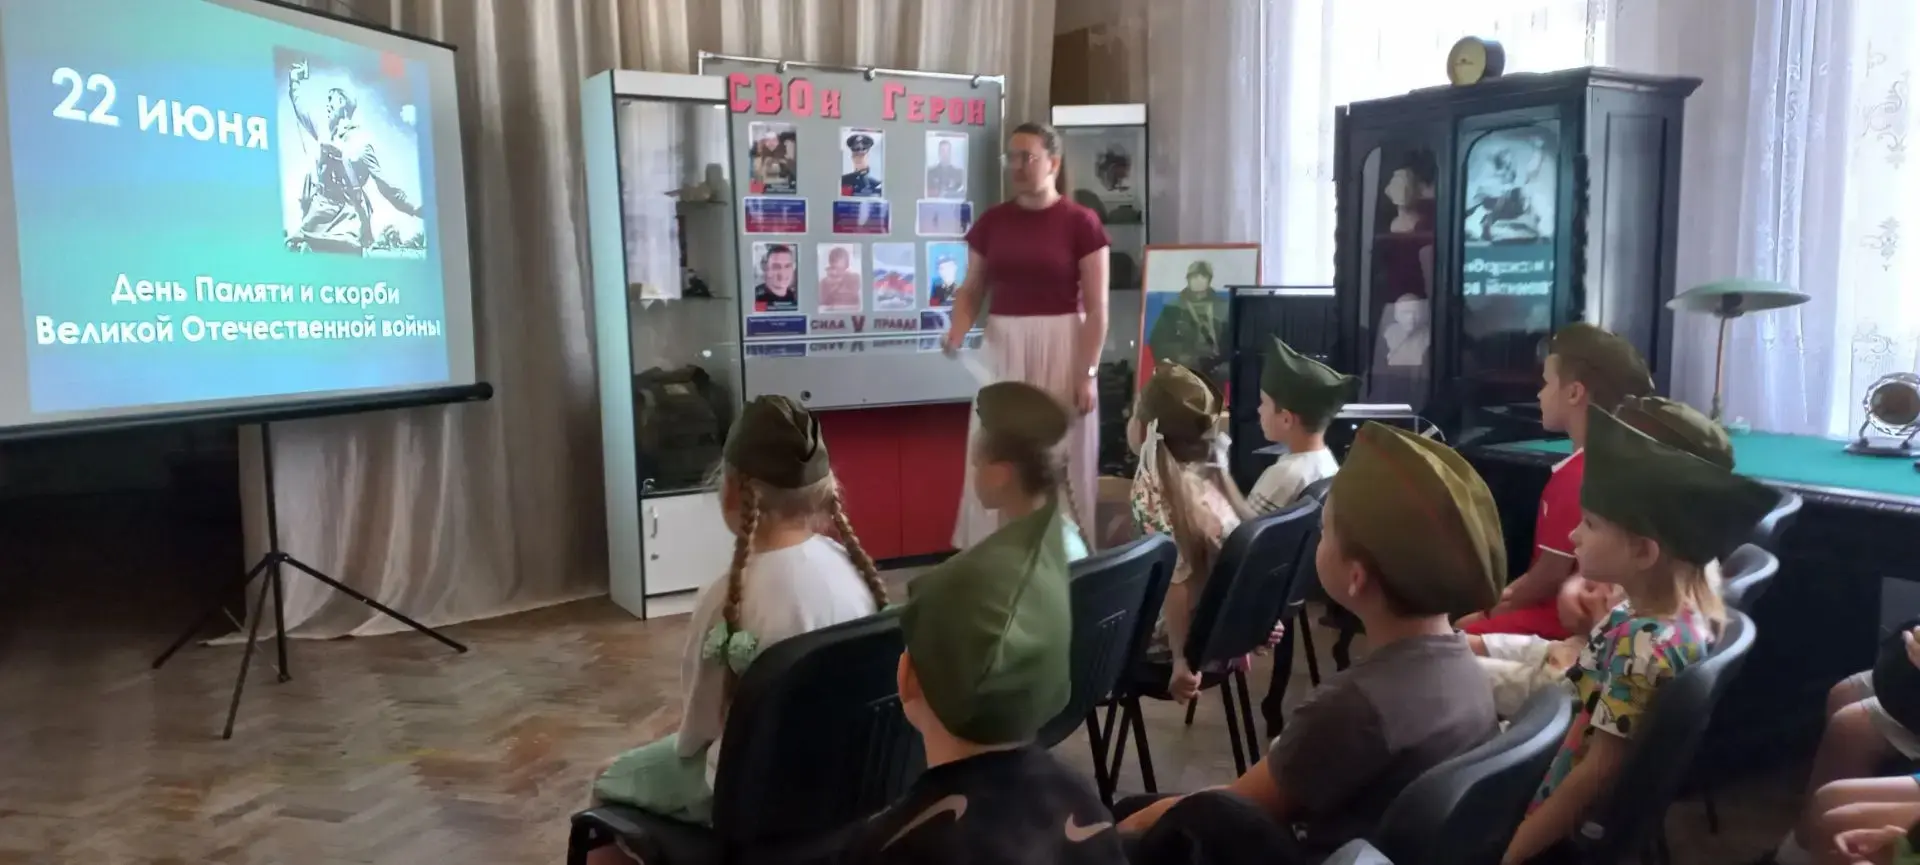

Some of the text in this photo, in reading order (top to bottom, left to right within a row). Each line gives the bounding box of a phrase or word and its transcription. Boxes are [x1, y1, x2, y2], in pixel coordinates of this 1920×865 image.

[52, 66, 268, 150] 22 июня
[110, 273, 400, 309] День Памяти и скорби
[36, 314, 441, 345] Великой Отечественной войны
[811, 317, 845, 331] СИЛА
[852, 315, 866, 332] V
